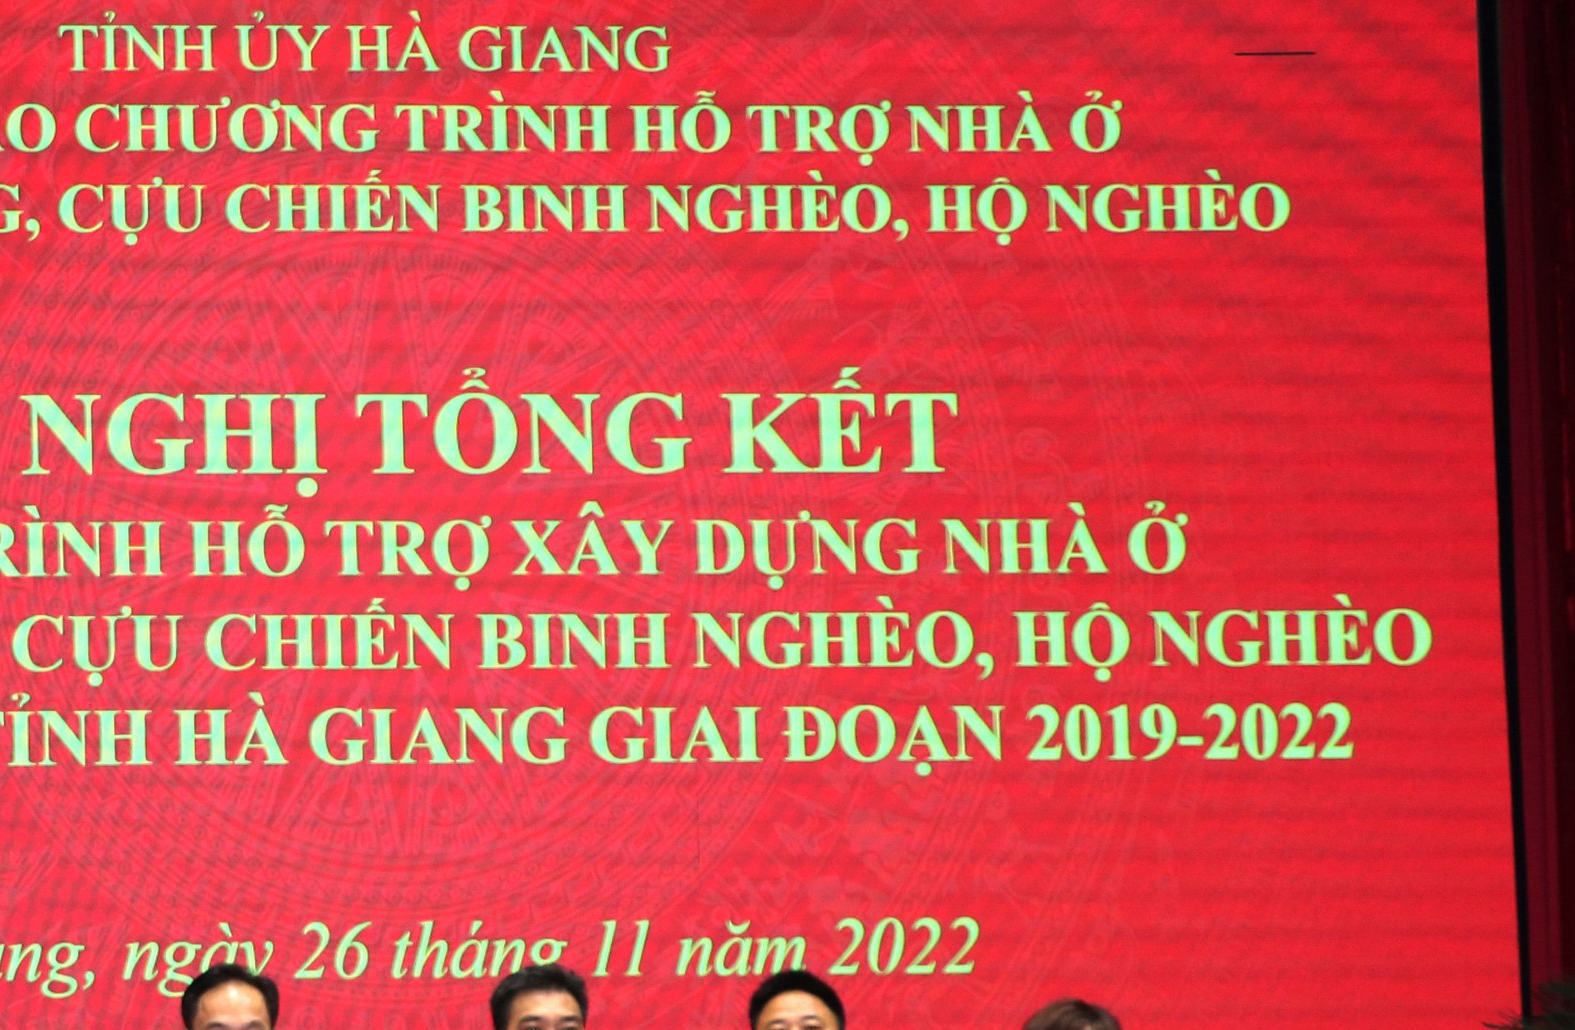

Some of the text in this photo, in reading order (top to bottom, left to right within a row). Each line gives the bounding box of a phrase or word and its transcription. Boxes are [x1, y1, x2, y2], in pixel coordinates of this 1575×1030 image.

[58, 10, 670, 72] TỈNH ỦY HÀ GIANG
[74, 96, 380, 152] CHƯƠNG
[394, 90, 611, 152] TRÌNH
[630, 90, 731, 152] HỖ
[746, 100, 891, 166] TRỢ
[905, 90, 1052, 152] NHÀ
[1070, 90, 1122, 152] Ở
[58, 176, 206, 246] CỰU
[225, 169, 441, 233] CHIẾN
[461, 185, 629, 232] BINH
[646, 169, 909, 241] NGHÈO,
[926, 177, 1027, 246] HỘ
[1044, 169, 1290, 232] NGHÈO
[19, 393, 328, 498] NGHỊ
[355, 367, 692, 474] TỔNG
[720, 367, 958, 473] KẾT
[188, 504, 305, 577] HỖ
[324, 515, 492, 591] TRỢ
[510, 501, 674, 575] XÂY
[692, 510, 921, 590] DỰNG
[941, 502, 1109, 573] NHÀ
[1128, 501, 1188, 574] Ở
[11, 605, 183, 687] CỰU
[204, 598, 455, 671] CHIẾN
[476, 613, 672, 669] BINH
[691, 595, 994, 679] NGHÈO,
[1013, 602, 1130, 682] HỘ
[1149, 594, 1432, 667] NGHÈO
[173, 692, 289, 765] HÀ
[309, 706, 569, 766] GIANG
[589, 706, 763, 764] GIAI
[781, 705, 1005, 776] ĐOẠN
[1027, 702, 1353, 761] 2019-2022
[294, 919, 371, 980] 26
[594, 920, 649, 978] 11
[675, 920, 806, 977] năm
[828, 917, 980, 976] 2022
